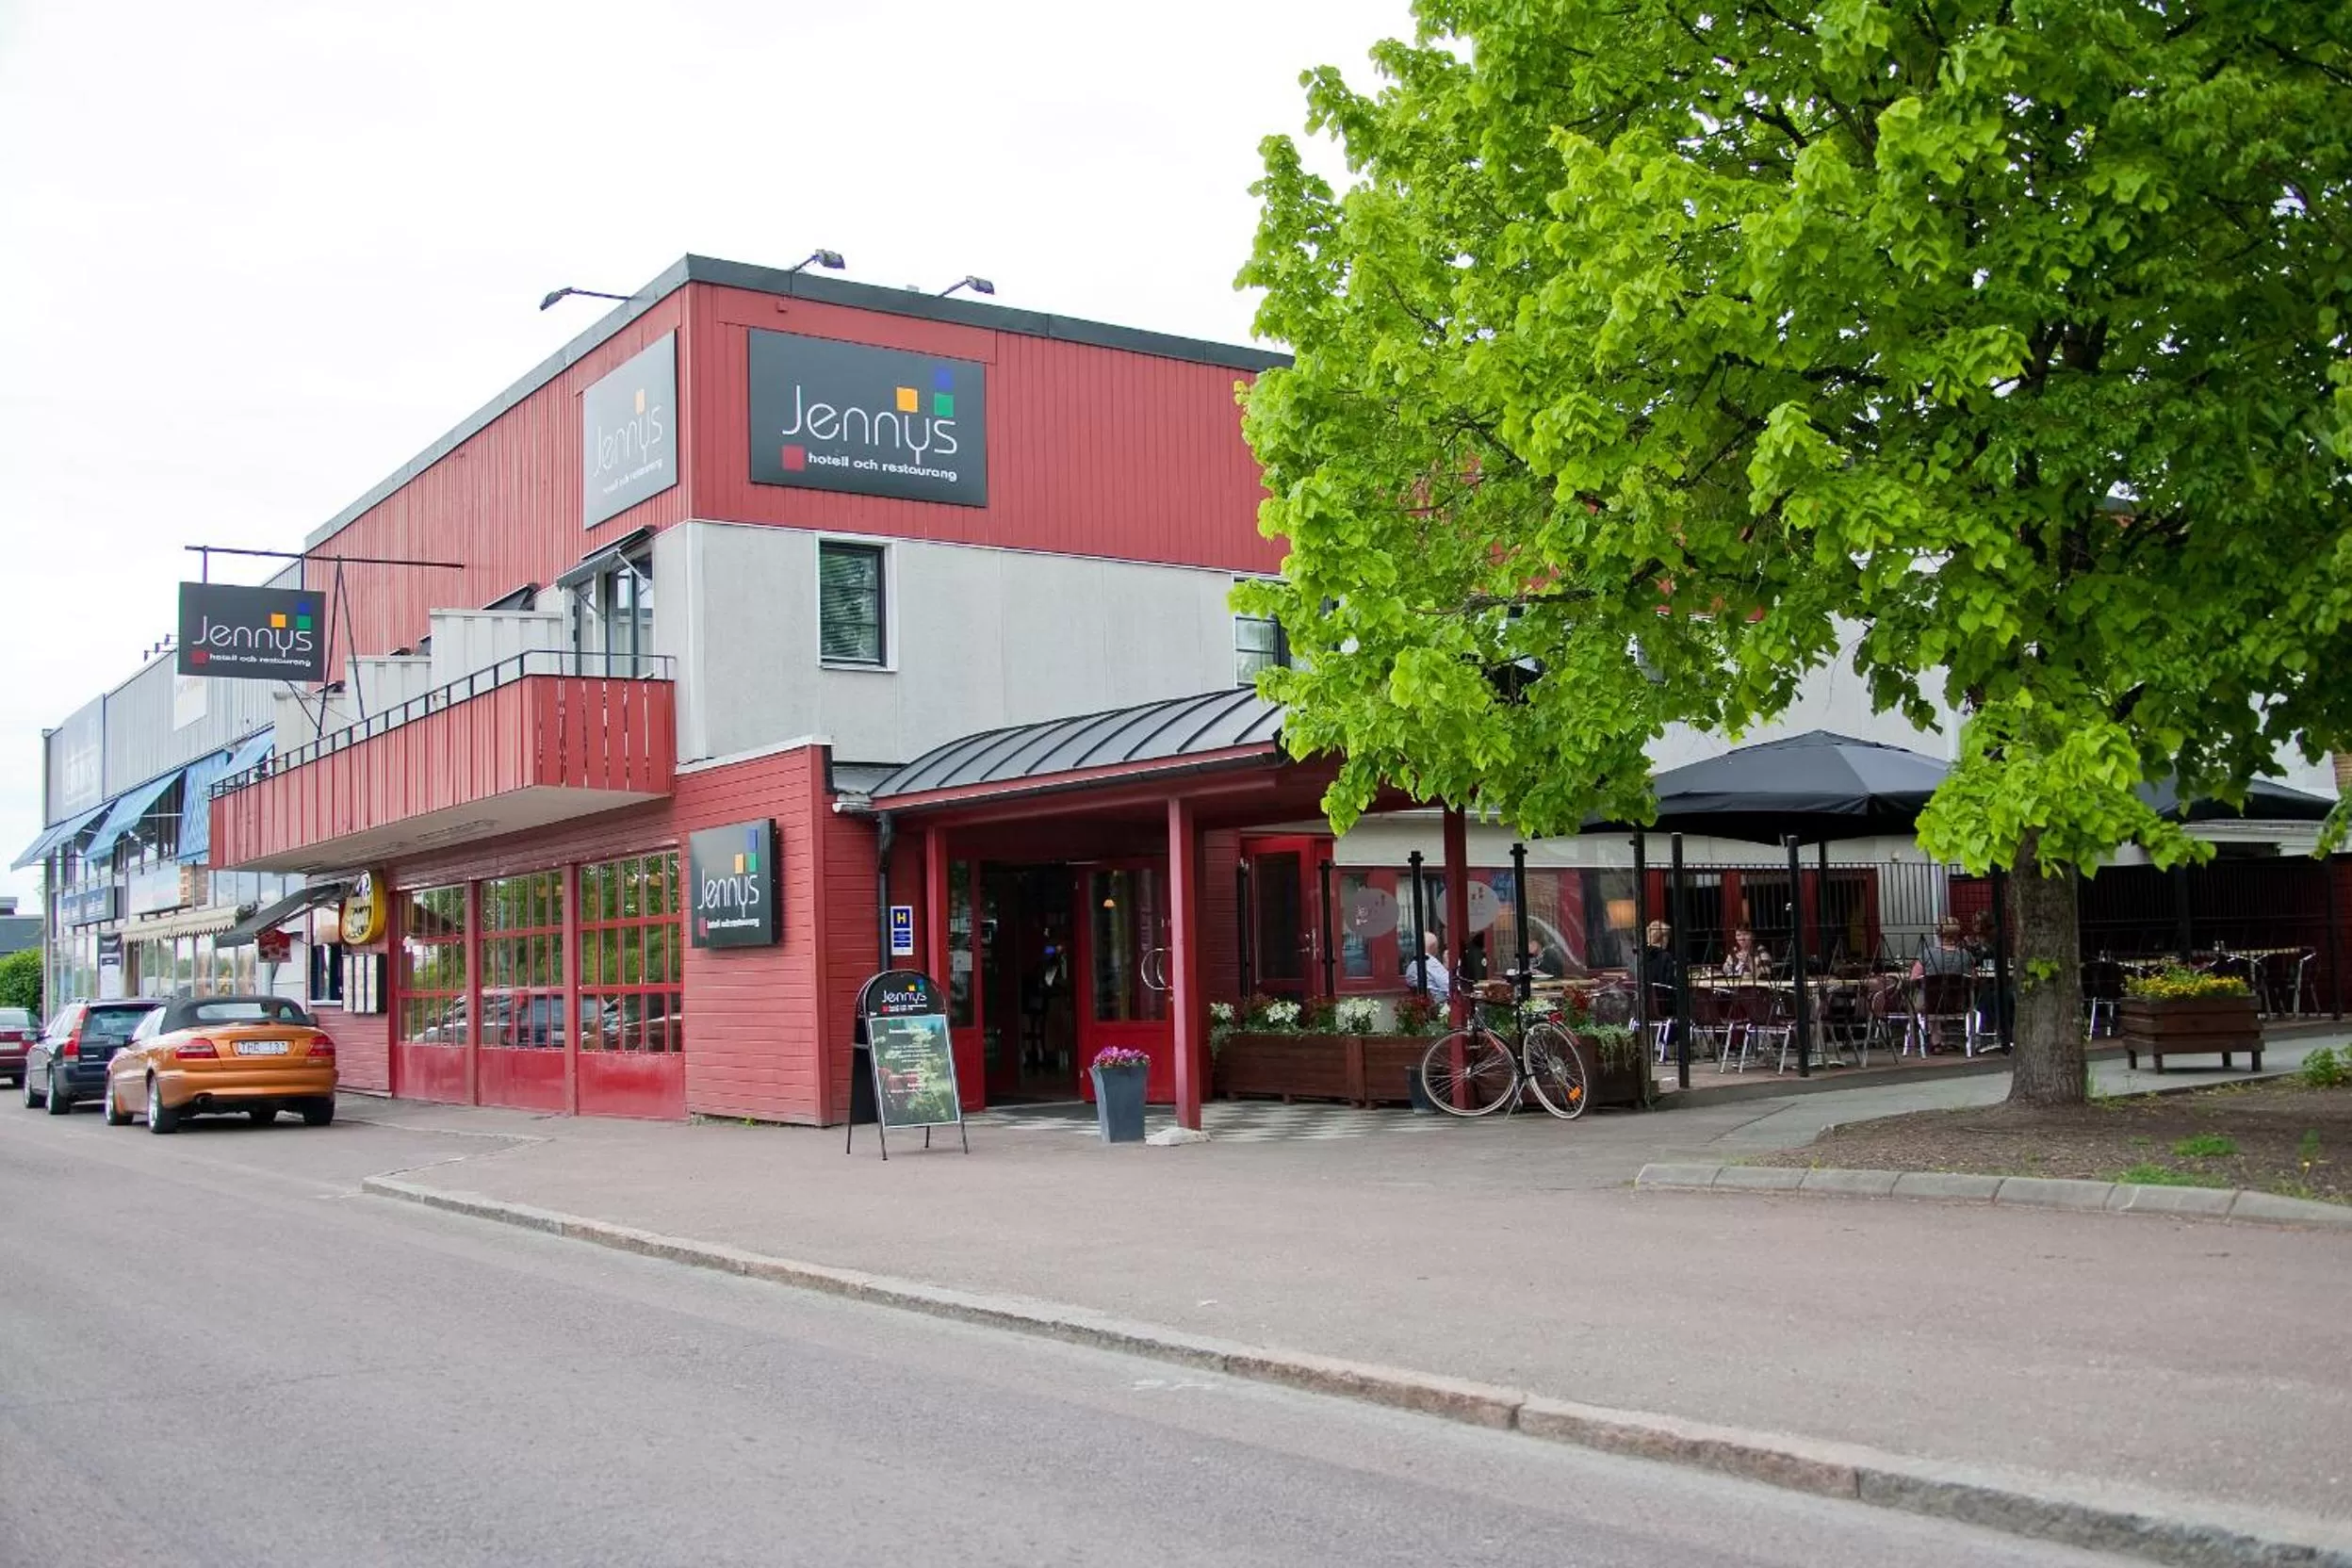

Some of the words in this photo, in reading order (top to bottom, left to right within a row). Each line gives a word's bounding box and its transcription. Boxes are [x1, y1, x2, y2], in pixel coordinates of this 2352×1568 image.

[593, 404, 663, 478] Jennys
[782, 384, 958, 466] Jennys
[808, 451, 849, 466] hotell
[854, 457, 878, 470] och
[882, 463, 957, 482] restaurang
[192, 615, 313, 658] Jennys
[697, 867, 760, 918] Jennys
[897, 912, 906, 923] H
[882, 989, 927, 1004] Jennys
